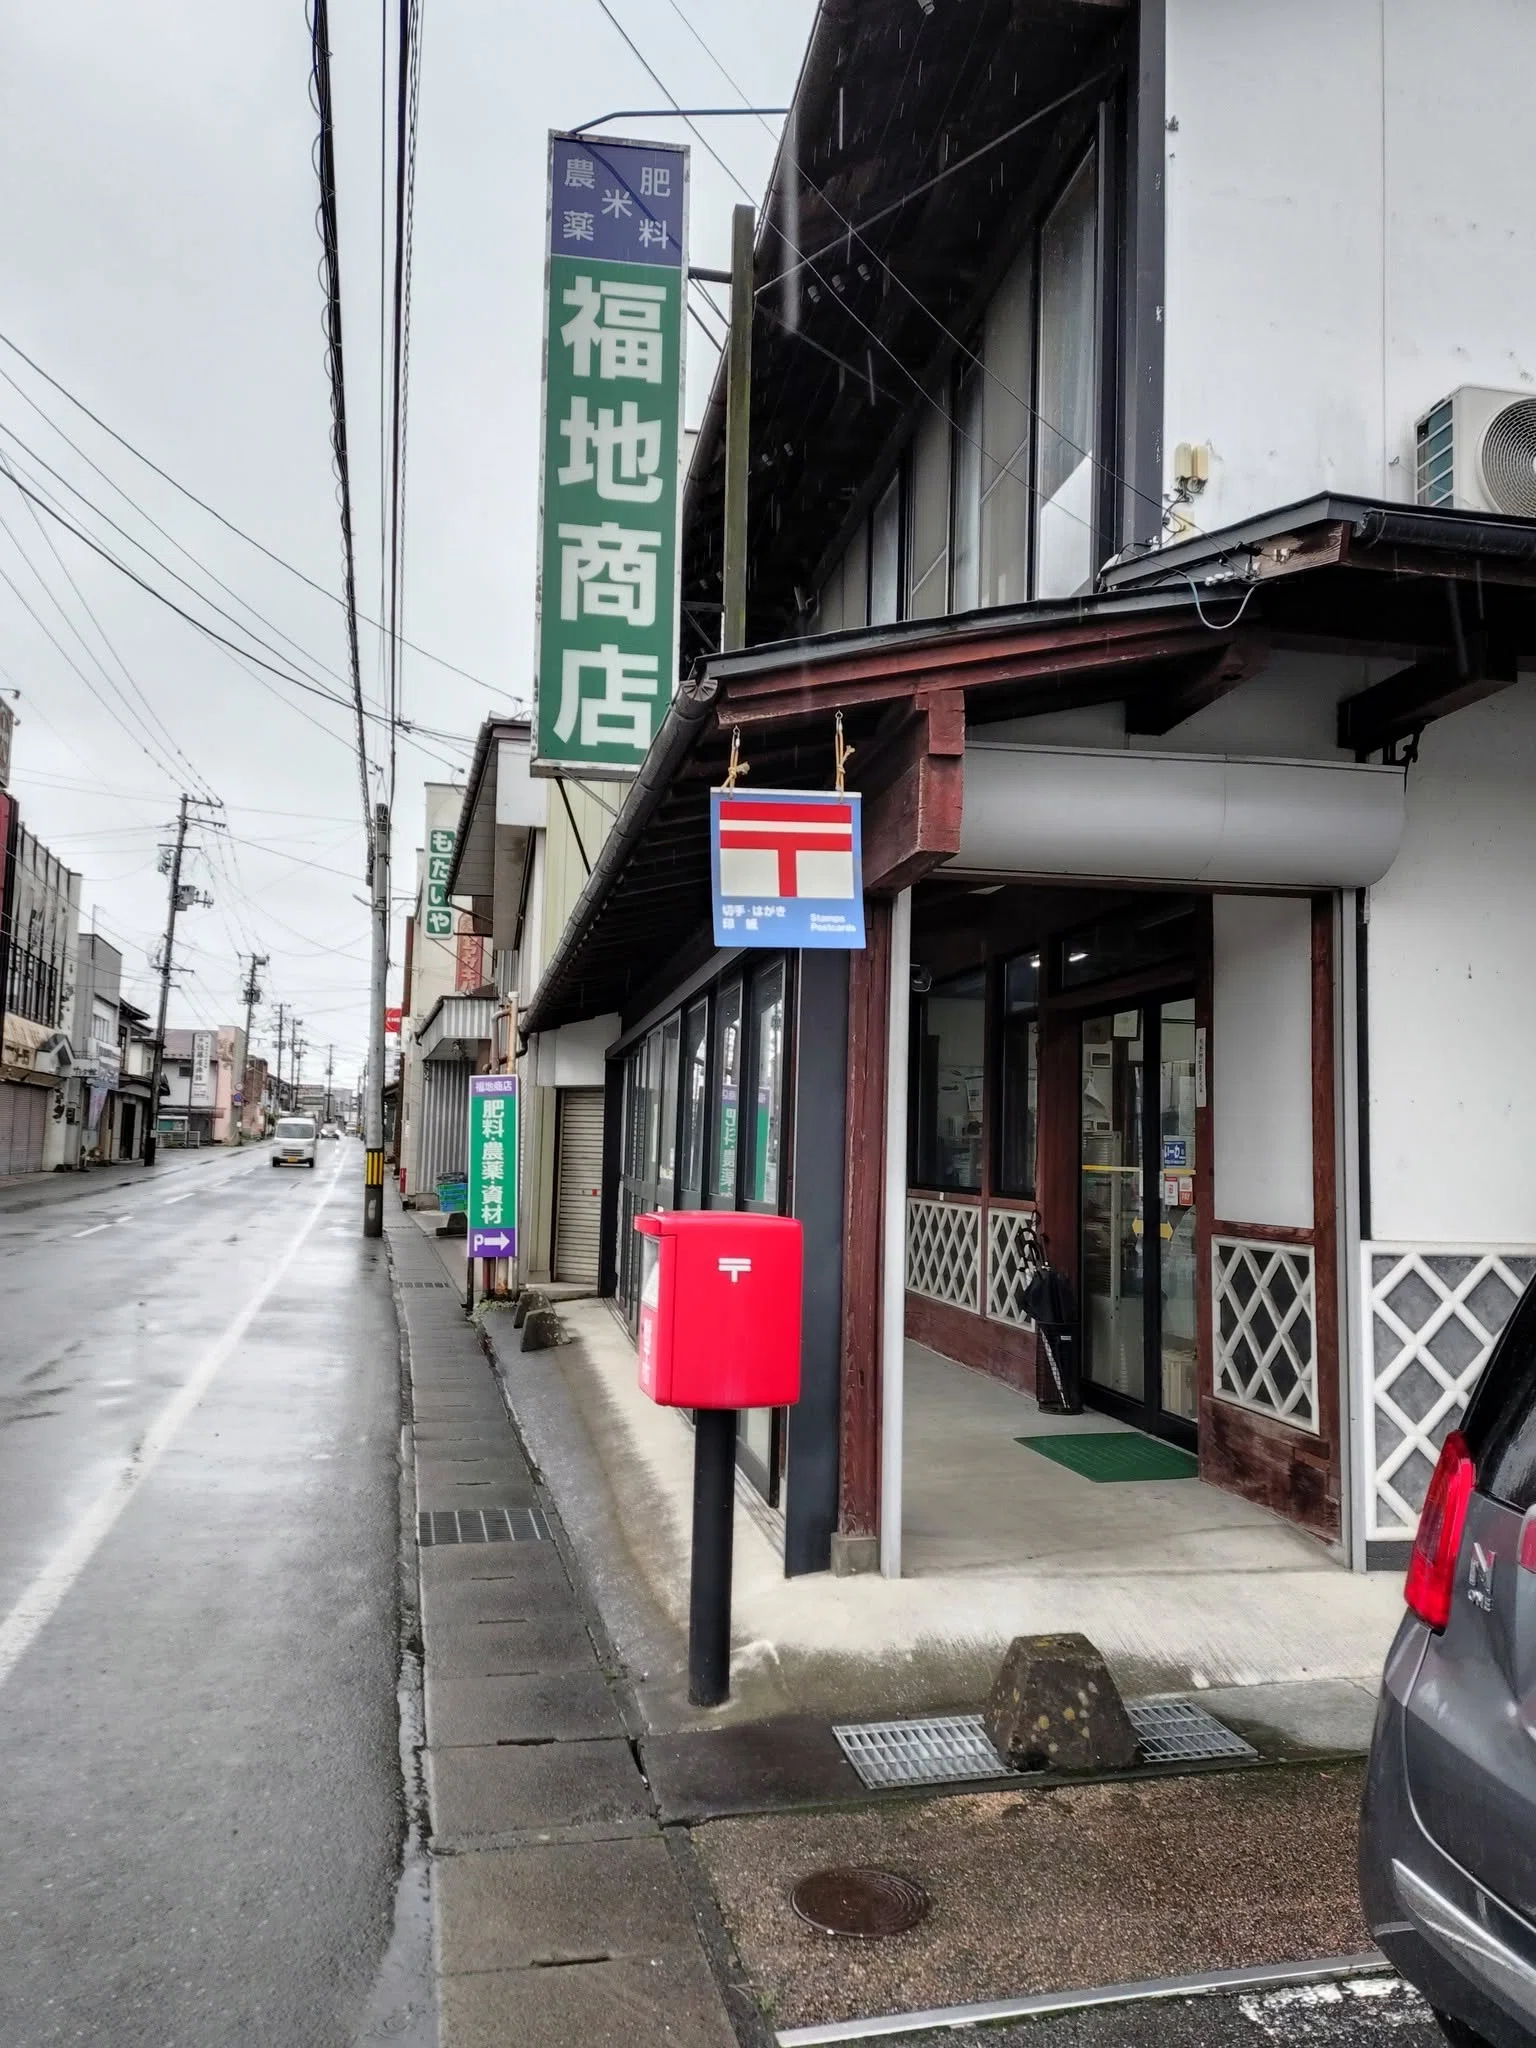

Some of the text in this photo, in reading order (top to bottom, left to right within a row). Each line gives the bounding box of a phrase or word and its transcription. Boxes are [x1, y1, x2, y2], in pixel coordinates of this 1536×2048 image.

[563, 158, 596, 241] 農薬
[601, 189, 632, 218] 米
[638, 167, 671, 249] 肥料
[554, 275, 667, 751] 福地商店
[810, 912, 846, 923] Stamps
[810, 922, 857, 932] Postcards
[475, 1080, 512, 1092] 福地商店
[481, 1099, 505, 1225] 肥料・農薬・資材
[474, 1233, 484, 1252] P
[1469, 1542, 1496, 1594] N
[1467, 1588, 1493, 1613] ONE
